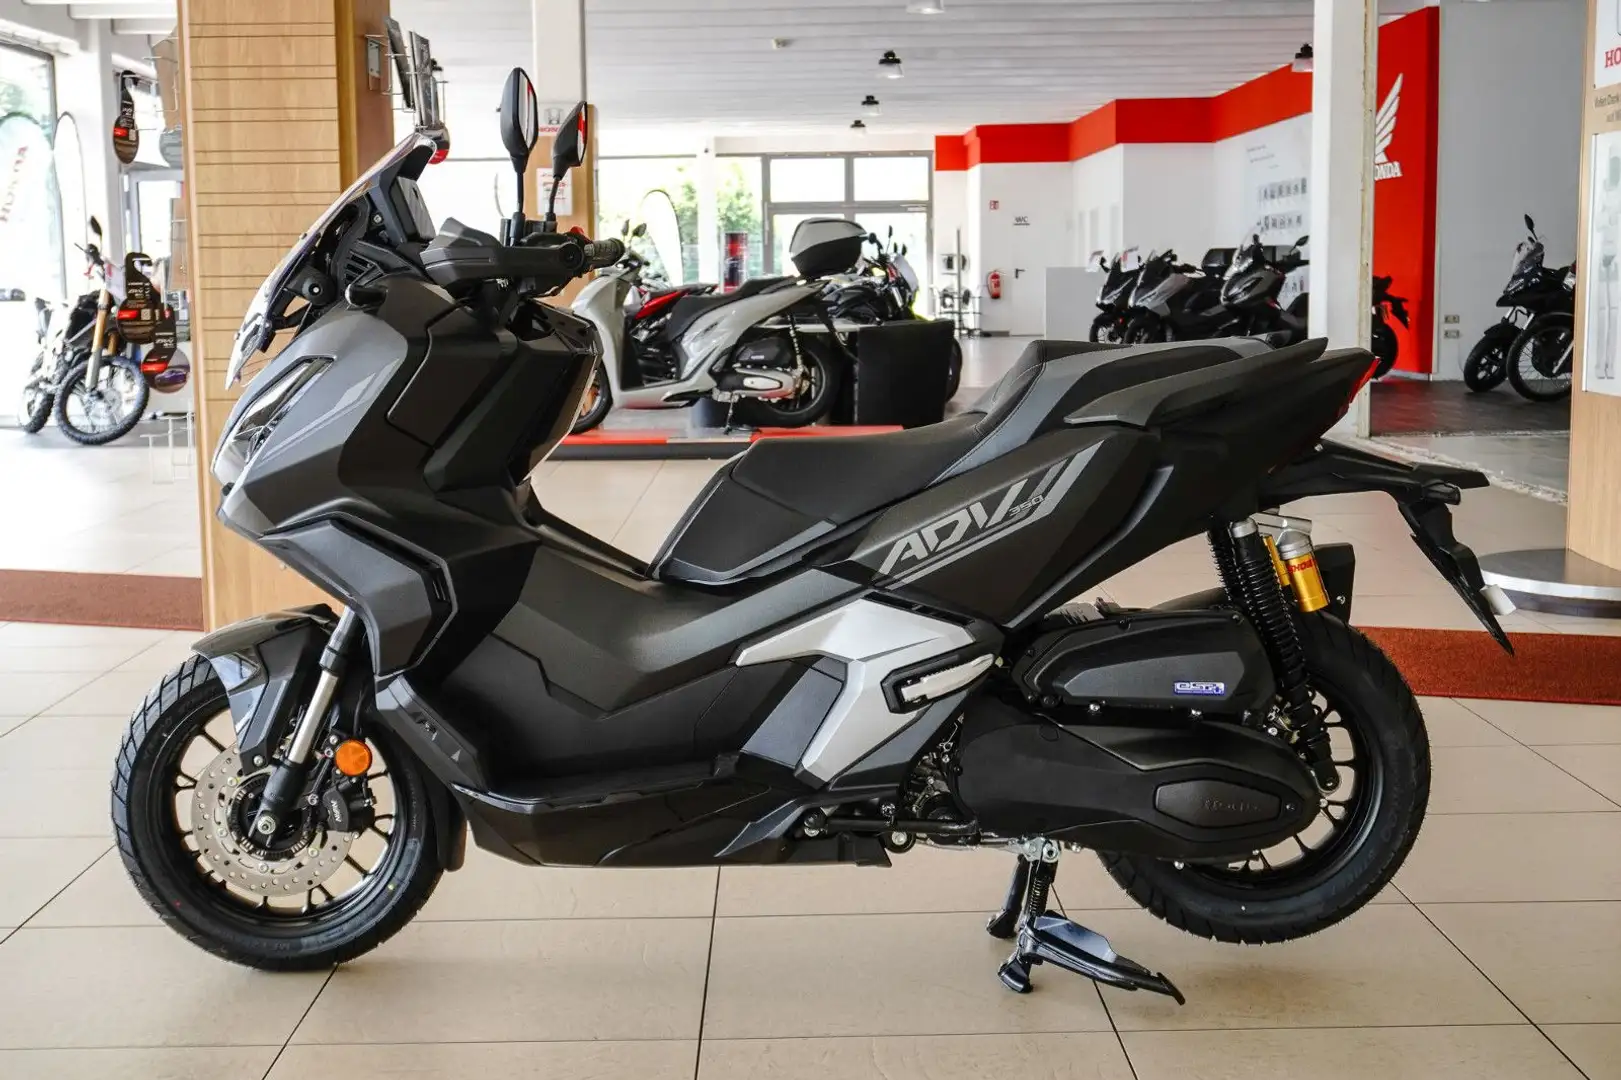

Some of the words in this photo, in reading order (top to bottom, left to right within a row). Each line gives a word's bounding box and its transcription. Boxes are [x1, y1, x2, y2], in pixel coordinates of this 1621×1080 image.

[1374, 161, 1403, 181] ONDA
[879, 478, 1028, 575] ADV
[1009, 494, 1046, 518] 350
